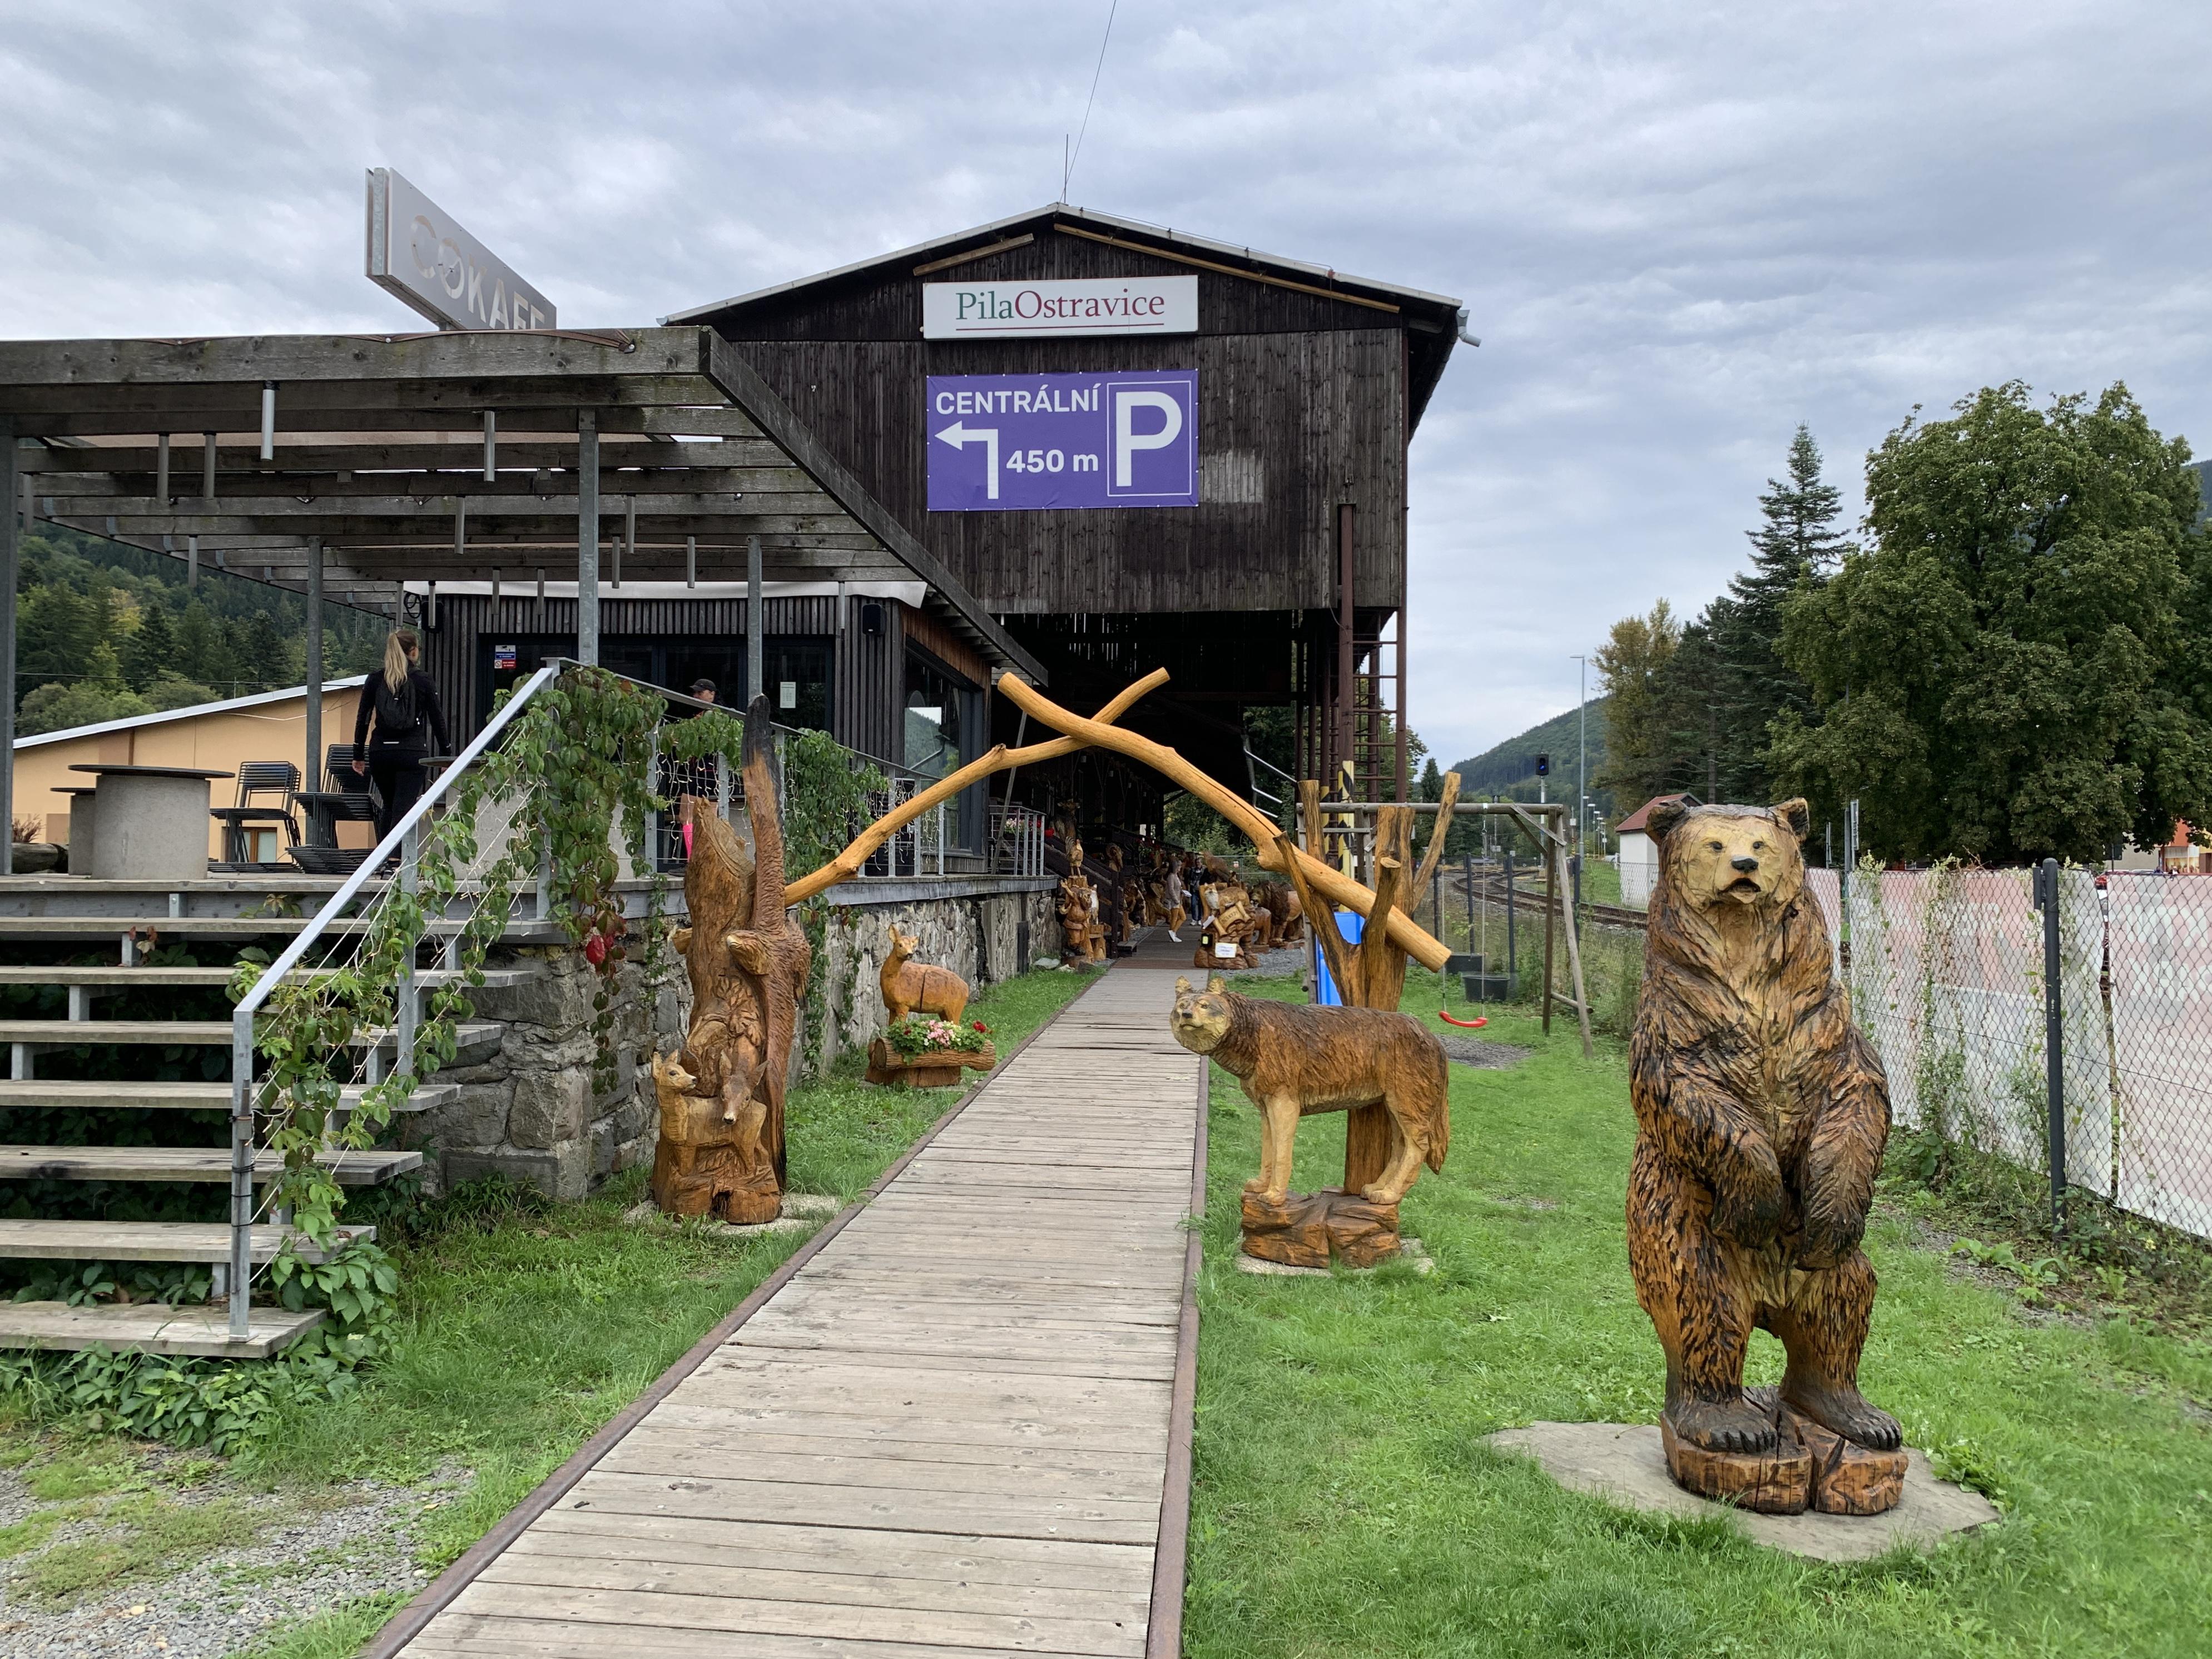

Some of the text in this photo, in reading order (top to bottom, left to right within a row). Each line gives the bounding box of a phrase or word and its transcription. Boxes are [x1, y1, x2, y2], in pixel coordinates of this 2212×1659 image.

[956, 289, 1165, 320] PilaOstravice
[936, 383, 1102, 414] CENTRÁLNÍ
[1116, 391, 1182, 486] P
[1006, 449, 1099, 473] 450 m
